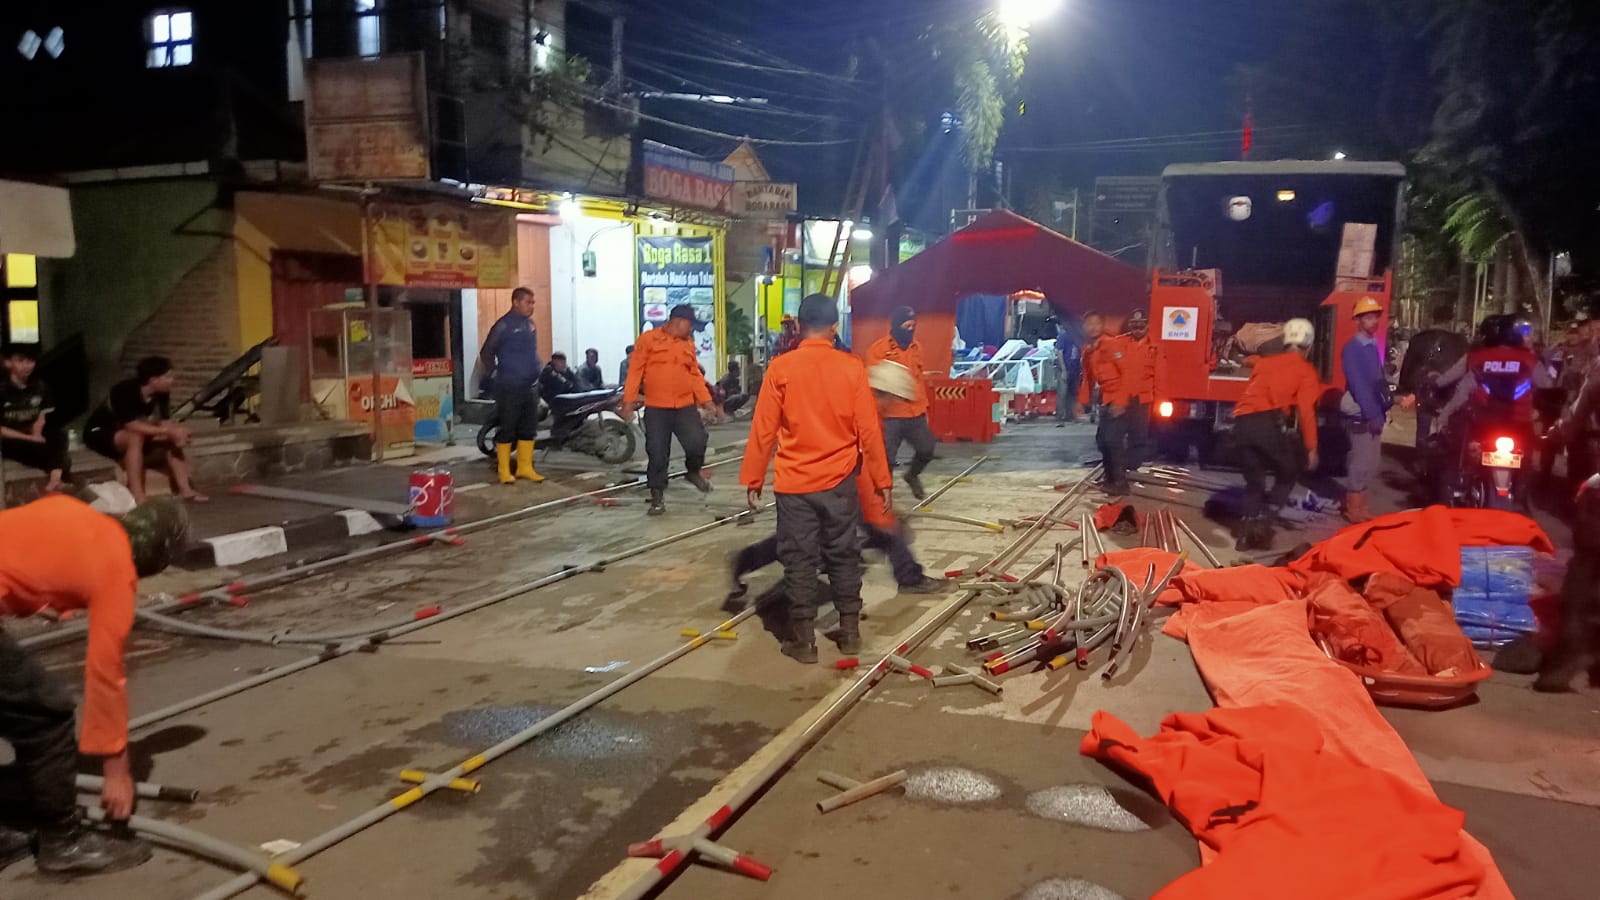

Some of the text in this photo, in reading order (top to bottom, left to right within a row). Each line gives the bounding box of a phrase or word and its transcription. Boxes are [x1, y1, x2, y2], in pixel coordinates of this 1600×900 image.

[648, 168, 691, 201] BOGA
[695, 179, 732, 211] RASA
[643, 242, 711, 269] Boga Rasa 1
[1483, 361, 1520, 373] POLISI
